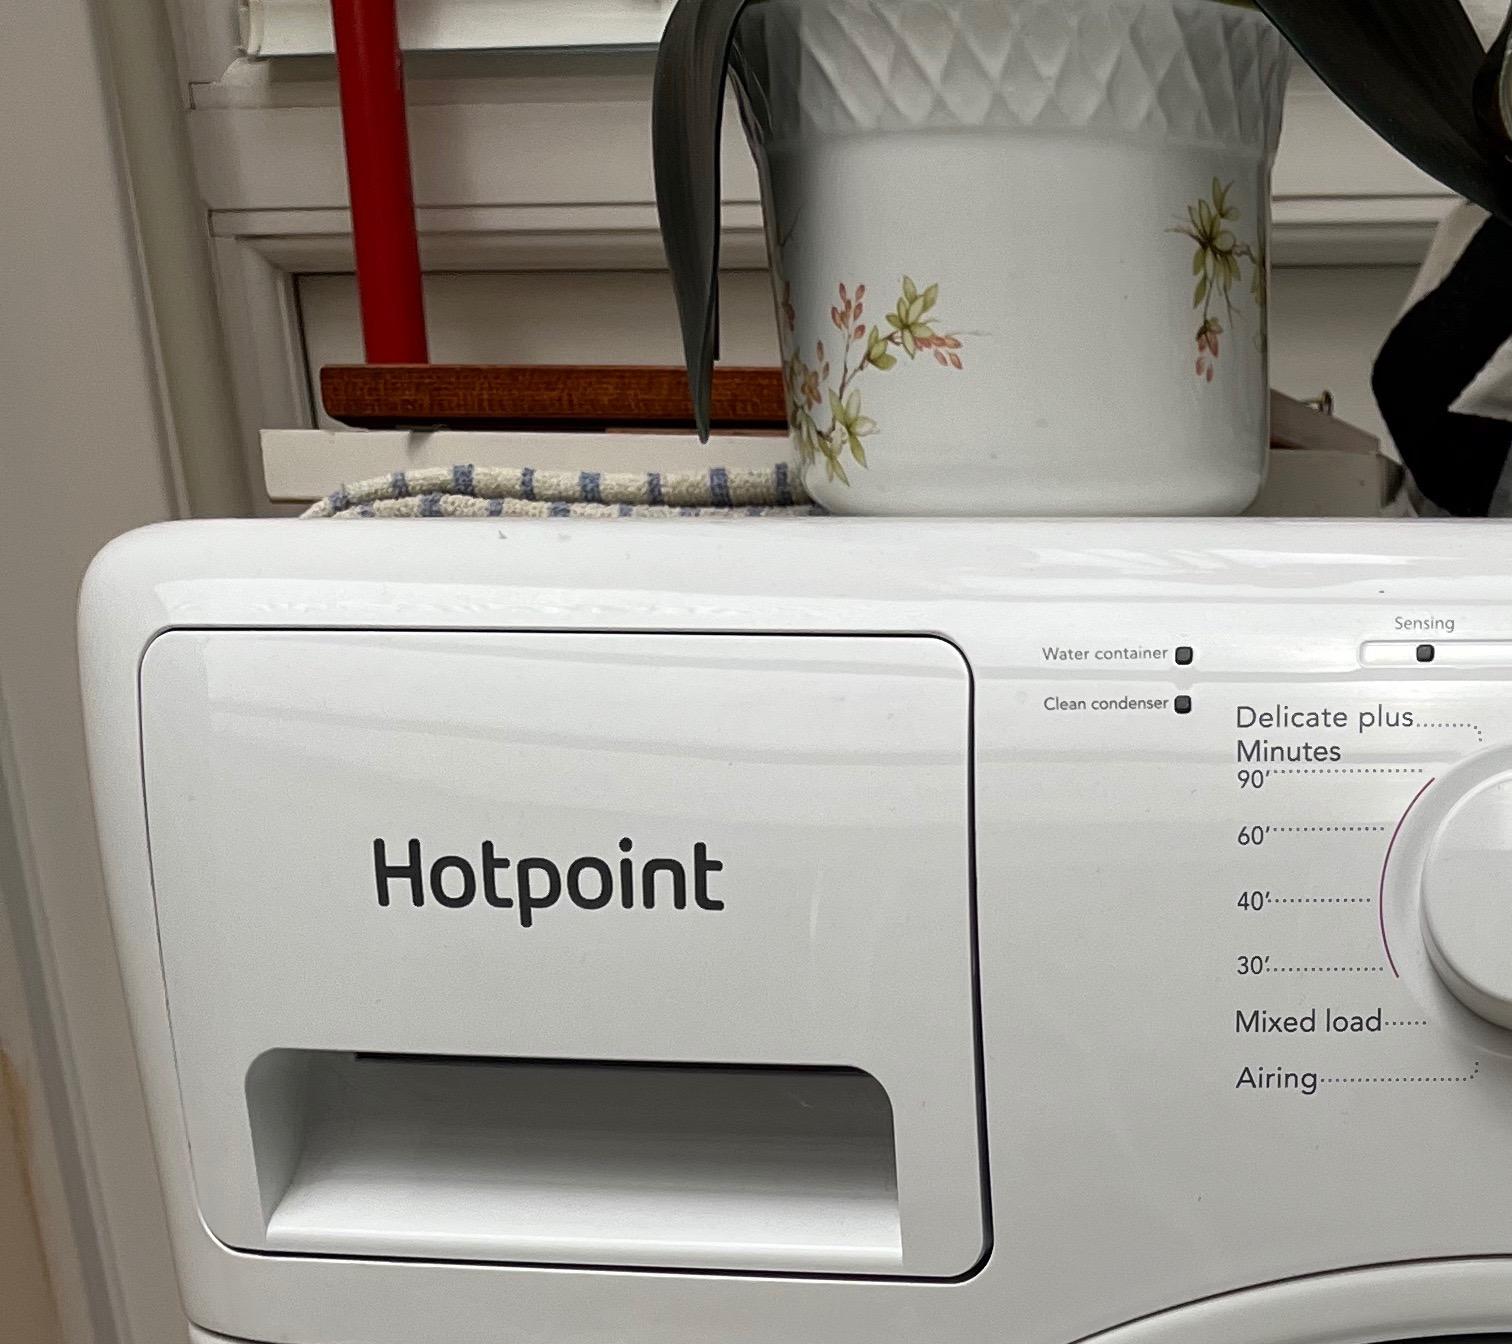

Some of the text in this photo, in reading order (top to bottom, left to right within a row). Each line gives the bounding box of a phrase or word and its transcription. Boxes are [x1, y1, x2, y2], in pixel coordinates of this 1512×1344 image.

[1394, 615, 1455, 632] Sensing
[1042, 646, 1168, 662] Water container
[1043, 696, 1169, 711] Clean condenser
[1236, 705, 1414, 733] Delicate plus
[1236, 739, 1341, 763] Minutes
[374, 838, 725, 929] Hotpoint
[1235, 1009, 1383, 1034] Mixed load
[1235, 1066, 1318, 1095] Airing
